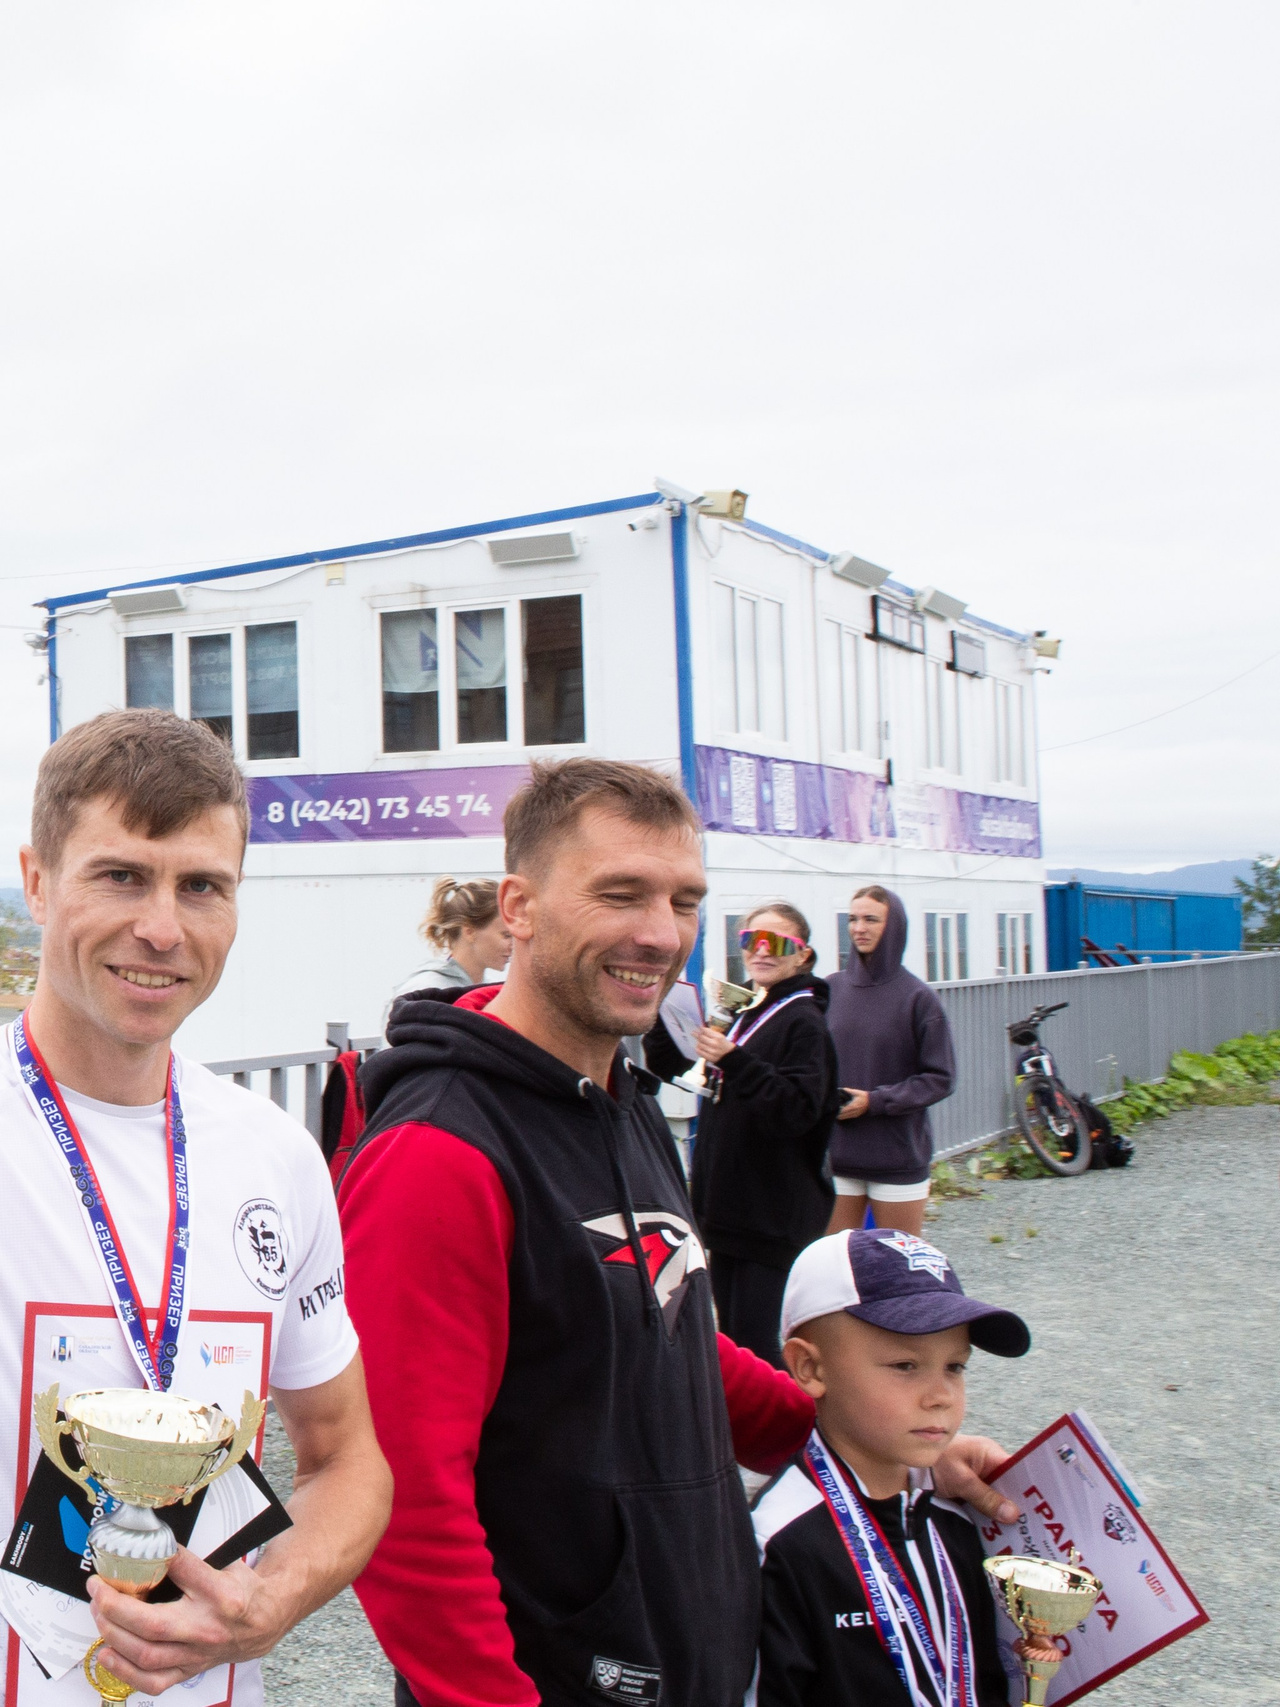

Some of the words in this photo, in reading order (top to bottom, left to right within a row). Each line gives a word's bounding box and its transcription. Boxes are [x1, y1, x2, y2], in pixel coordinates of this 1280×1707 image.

[268, 802, 284, 823] 8
[291, 797, 370, 827] (4242)
[377, 797, 410, 819] 73
[416, 796, 451, 817] 45
[456, 794, 492, 816] 74
[14, 1014, 27, 1053] ПРИЗ
[263, 1245, 278, 1262] 65
[298, 1263, 345, 1321] HTTPS:/
[213, 1346, 234, 1365] ЦСП
[1022, 1485, 1119, 1632] ГРАТА
[835, 1608, 906, 1628] KELE
